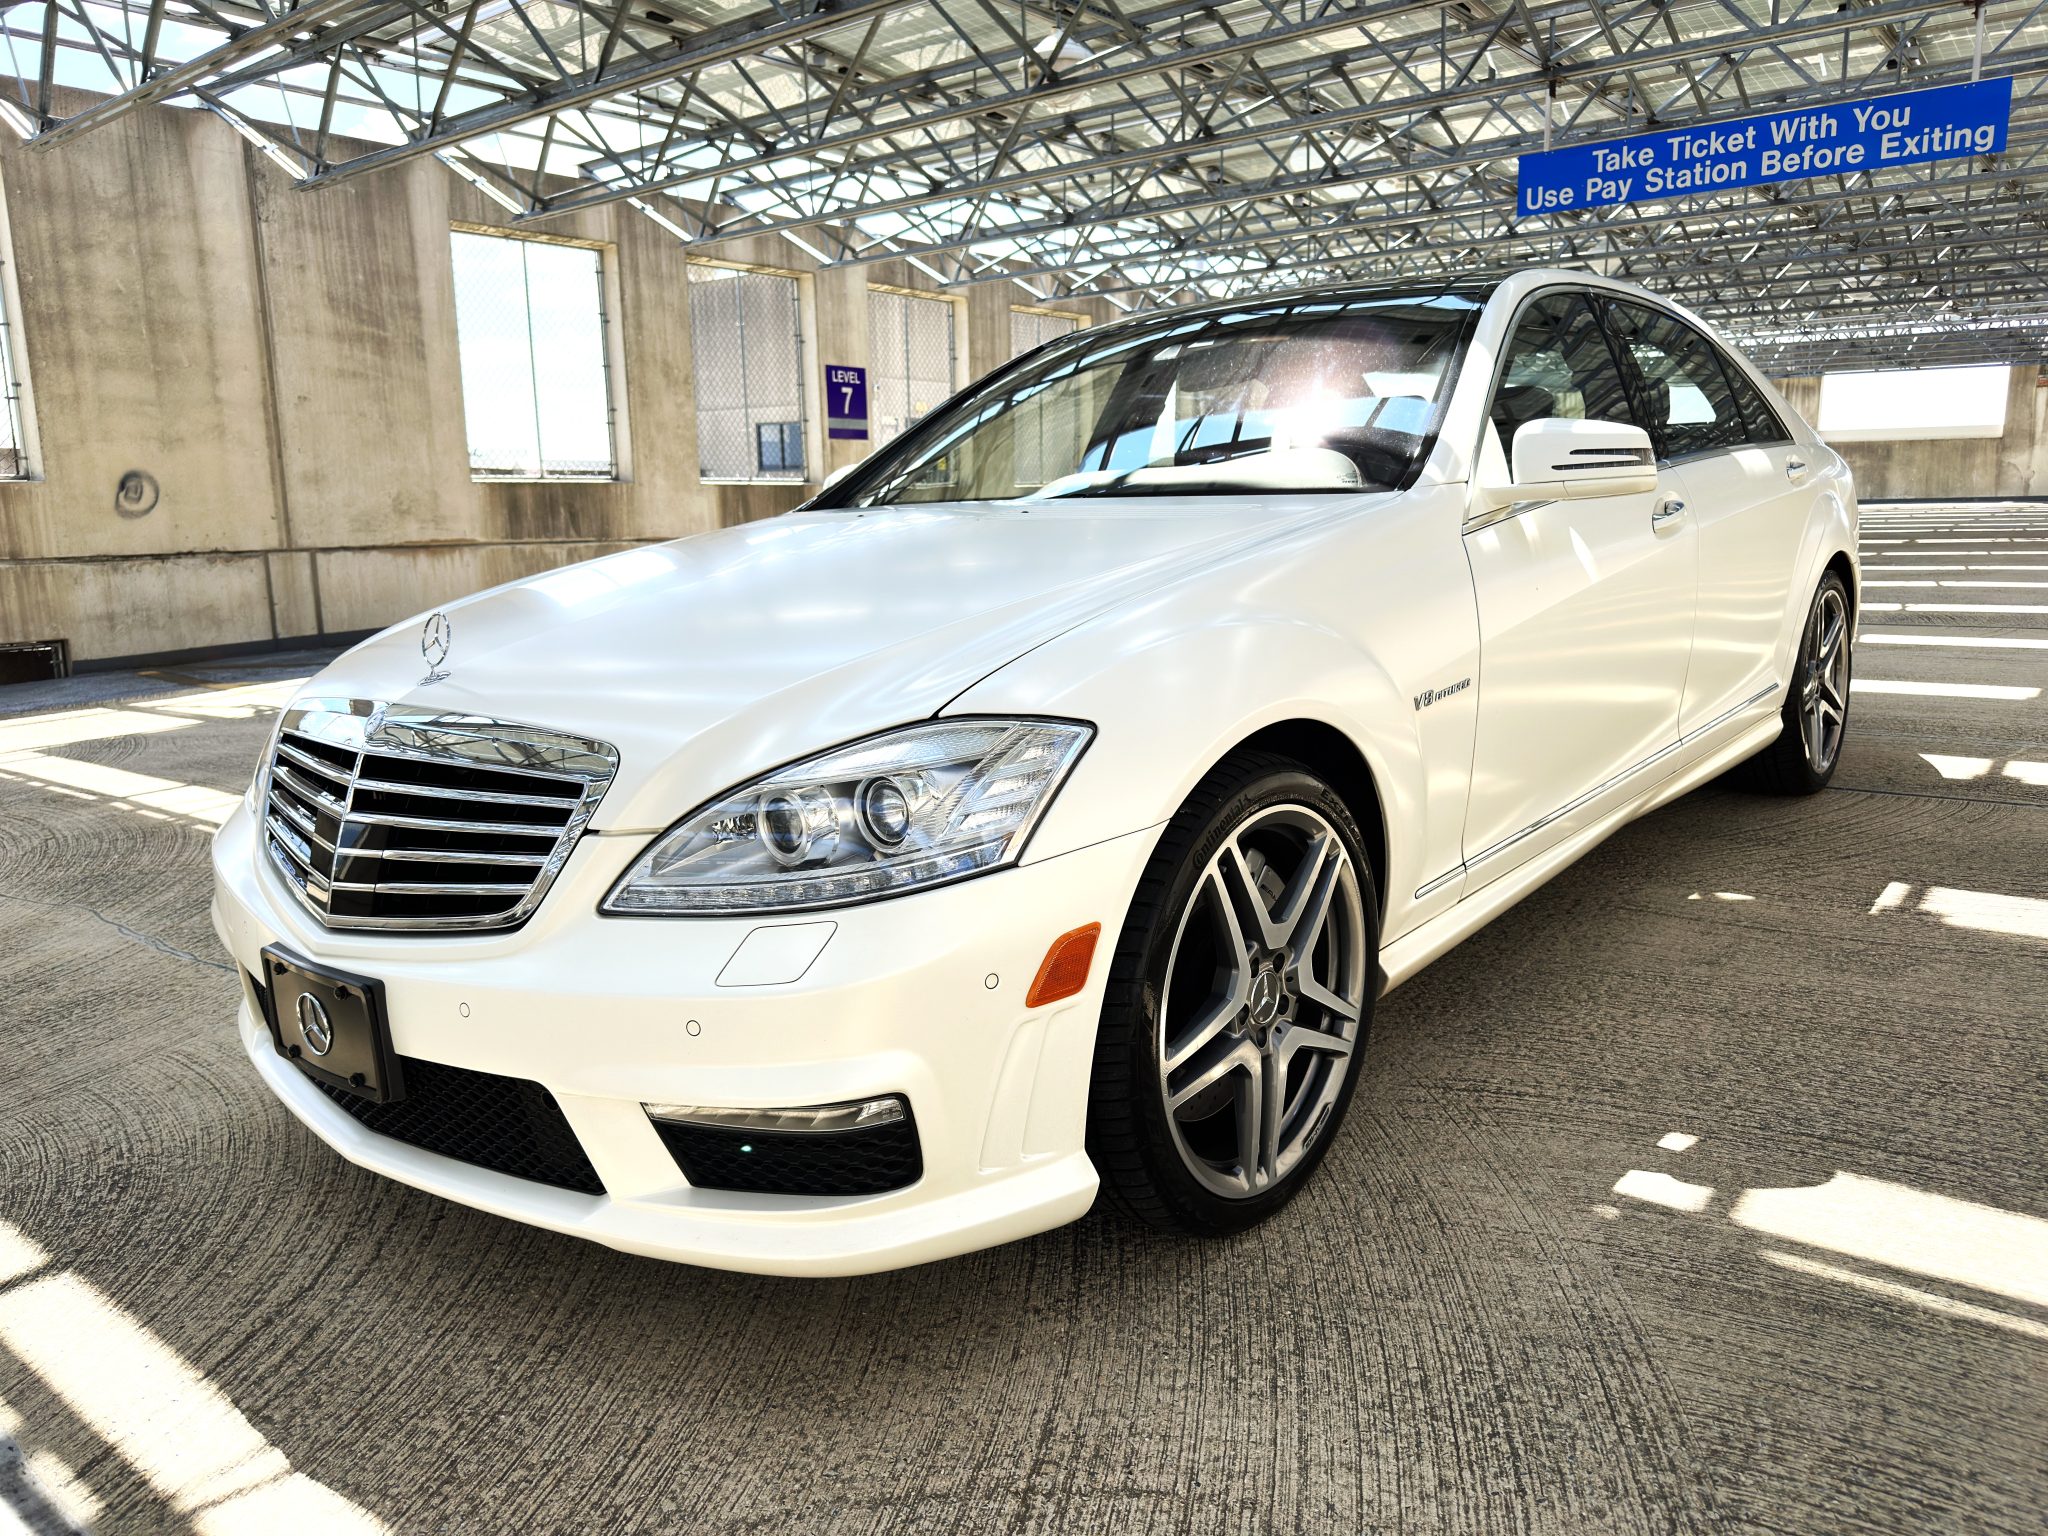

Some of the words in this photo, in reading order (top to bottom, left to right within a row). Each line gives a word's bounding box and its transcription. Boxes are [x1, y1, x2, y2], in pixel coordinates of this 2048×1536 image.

[1592, 147, 1655, 174] Take
[1667, 125, 1757, 161] Ticket
[1770, 112, 1838, 146] With
[1852, 105, 1911, 134] You
[1526, 186, 1574, 211] Use
[1586, 177, 1633, 202] Pay
[1645, 160, 1747, 193] Station
[1761, 143, 1865, 177] Before
[1881, 123, 1995, 161] Exiting
[832, 370, 861, 384] LEVEL
[841, 386, 853, 414] 7
[1413, 689, 1434, 711] V8
